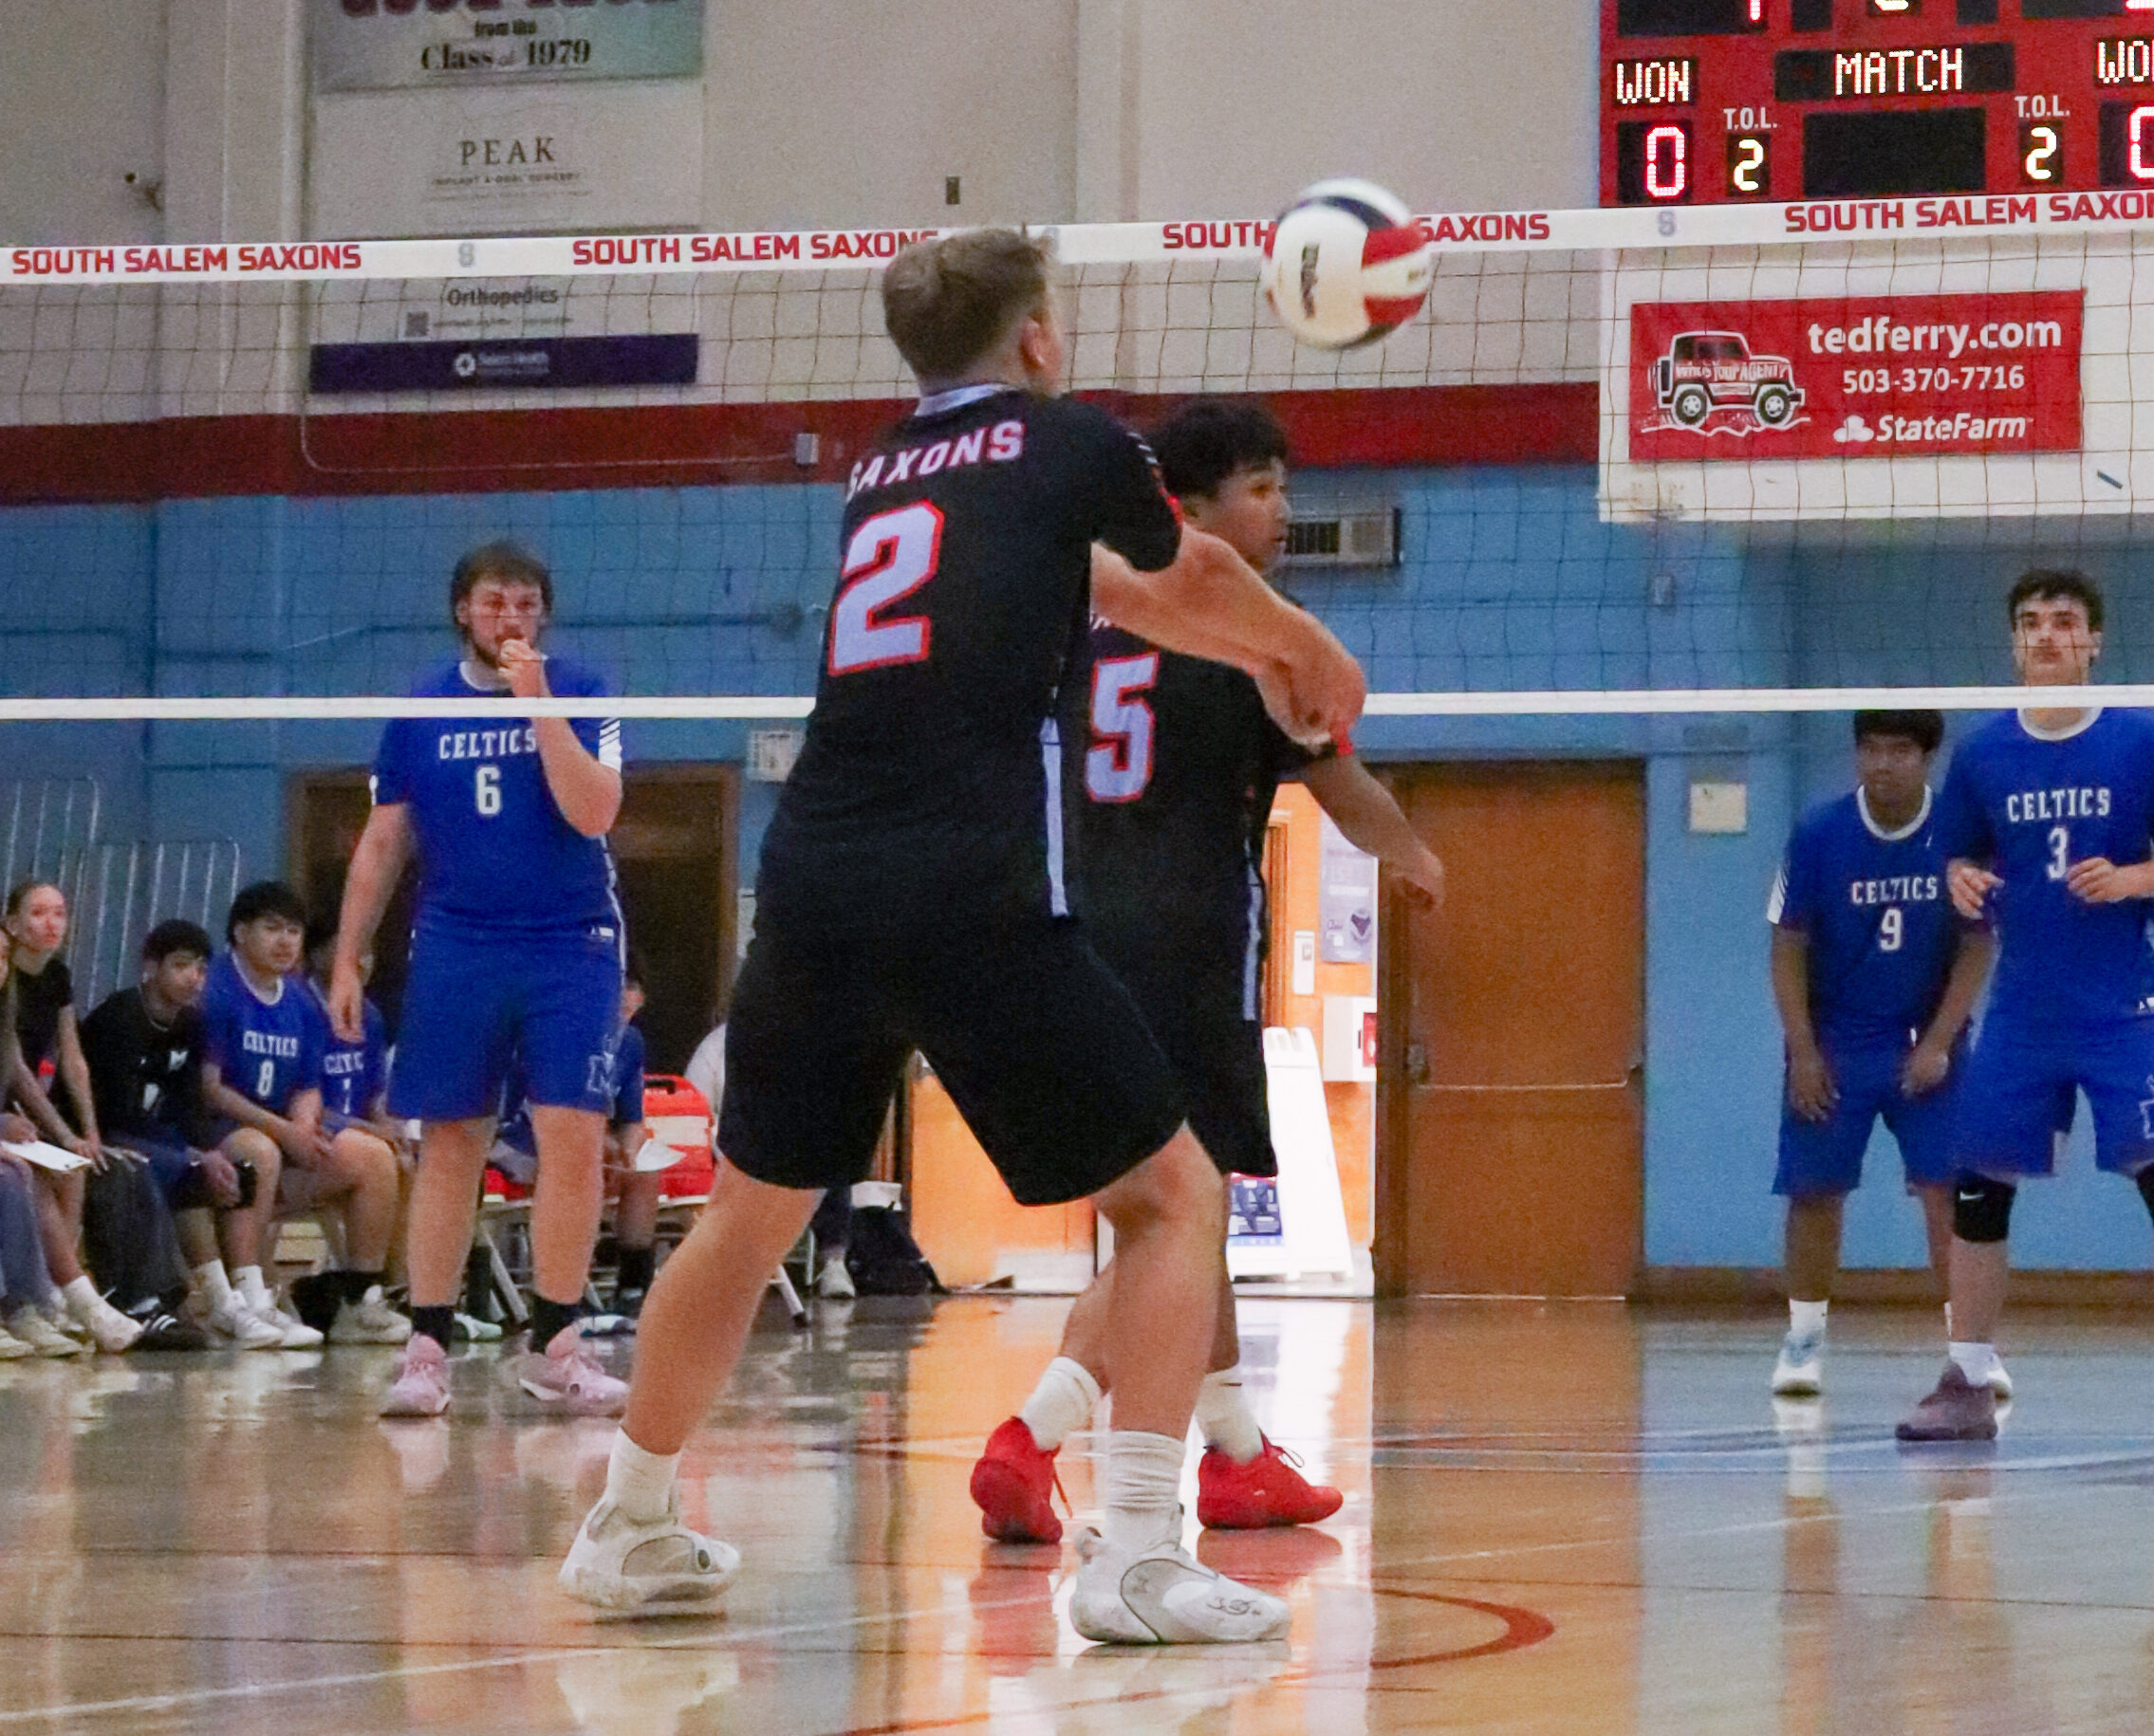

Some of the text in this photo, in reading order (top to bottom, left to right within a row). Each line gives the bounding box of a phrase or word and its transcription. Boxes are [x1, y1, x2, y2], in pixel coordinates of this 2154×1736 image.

[421, 43, 492, 69] Class
[529, 39, 590, 65] 1979
[1835, 47, 1962, 95] MATCH
[2097, 40, 2154, 83] WO
[1617, 60, 1689, 104] WON
[1723, 106, 1778, 130] T.O.L.
[2014, 94, 2070, 118] T.O.L.
[459, 137, 555, 166] PEAK
[1646, 125, 1685, 197] 0
[1734, 139, 1764, 191] 2
[2026, 126, 2057, 179] 2
[1418, 213, 1550, 244] SAXONS
[1785, 193, 2154, 232] SOUTH SALEM SAXO
[12, 244, 362, 275] SOUTH SALEM SAXONS
[573, 237, 679, 266] SOUTH
[692, 234, 800, 261] SALEM
[447, 286, 558, 308] Orthopedics
[1808, 316, 2062, 359] tedferry.com
[1843, 364, 2025, 394] 503-370-7716
[828, 499, 945, 677] 2
[439, 728, 537, 759] CELTICS
[1086, 651, 1160, 803] 5
[476, 765, 501, 816] 6
[2007, 787, 2111, 822] CELTICS
[2048, 825, 2069, 880] 3
[1852, 877, 1938, 904] CELTICS
[1880, 908, 1902, 951] 9
[257, 1059, 275, 1098] 8
